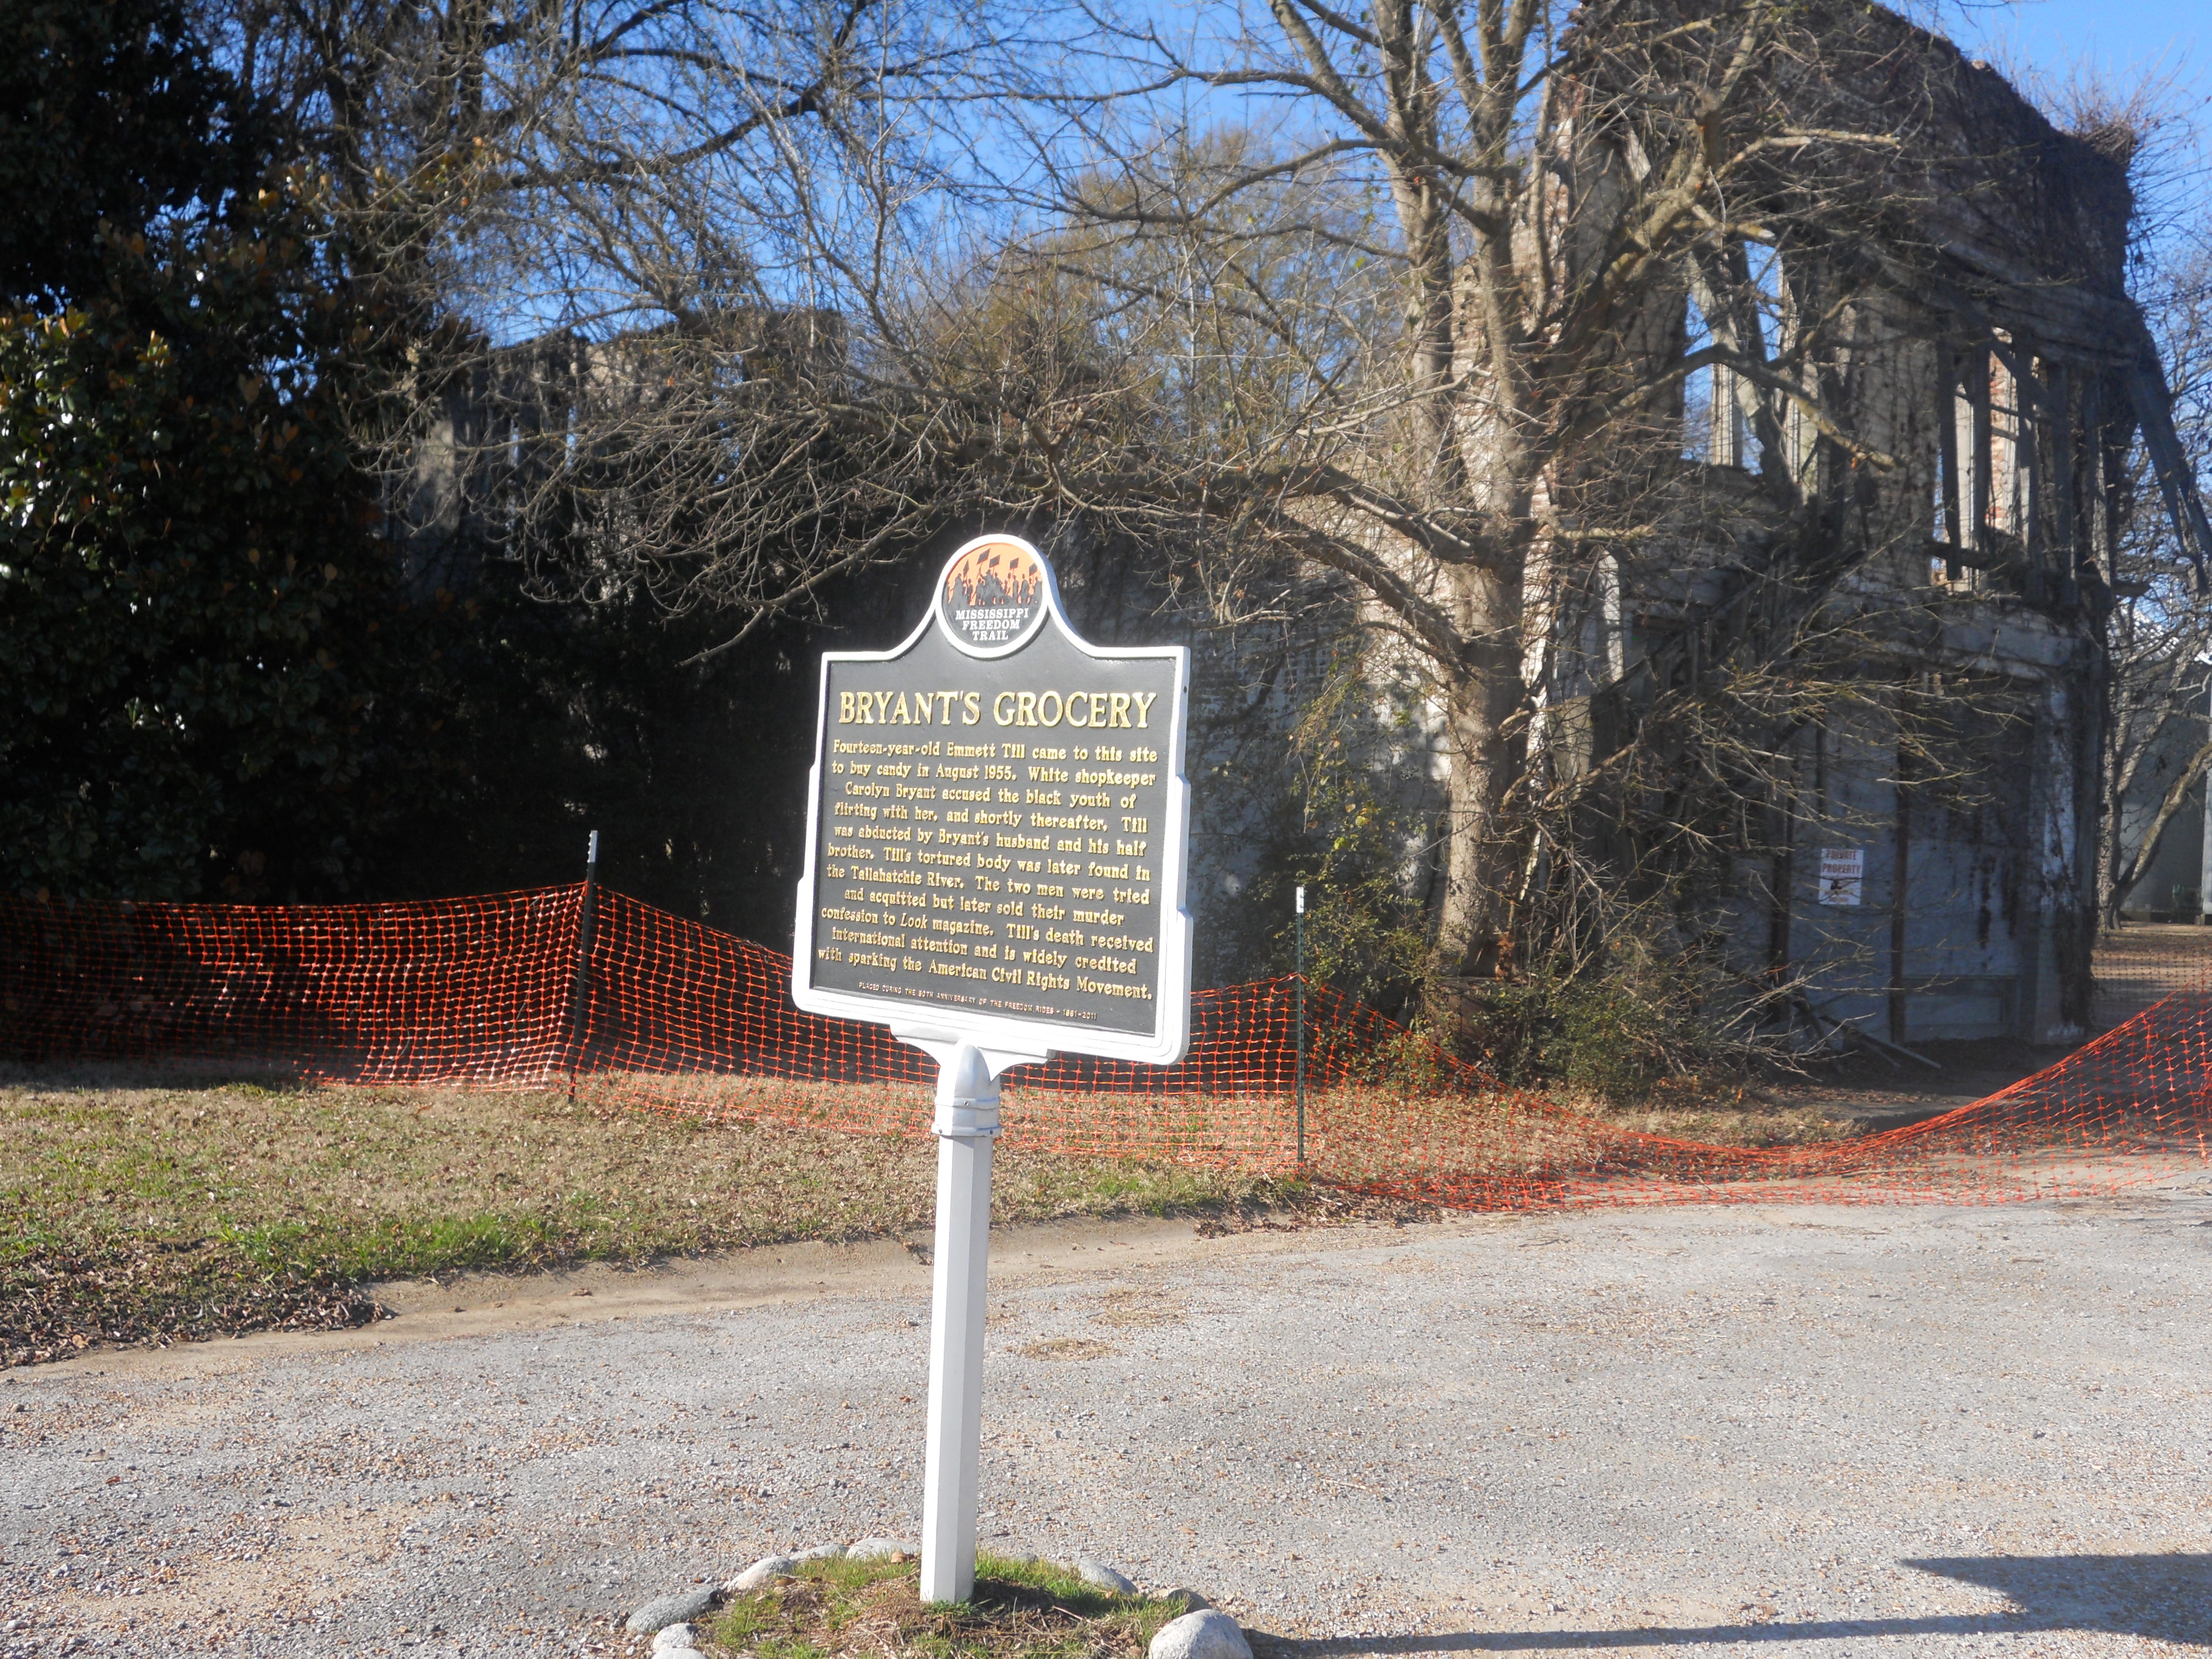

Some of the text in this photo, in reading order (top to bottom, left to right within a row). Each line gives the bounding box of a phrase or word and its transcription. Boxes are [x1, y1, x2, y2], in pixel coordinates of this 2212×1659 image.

[955, 608, 1029, 620] MISSISSIPPI
[962, 619, 1020, 630] FREEDOM
[972, 630, 1009, 640] TRAIL
[839, 691, 1157, 728] BRYANT'S GROCERY
[833, 739, 1157, 762] Fourteen-year-old Emmett Till came to this site
[832, 760, 1156, 789] to buy candy in August 1955. White shopkeeper
[845, 781, 1136, 808] Carolyn Bryant accused the black youth of
[834, 802, 1147, 833] flirting with her, and shortly thereafter, Till
[834, 825, 1147, 857] was abducted by Bryant's husband and his half
[1827, 849, 1856, 859] PRIVATE
[827, 842, 1150, 881] brother. Till's tortured body was later found in
[1822, 864, 1861, 873] PROPERTY
[827, 864, 1150, 905] the Tallahatchie River. The two men were tried
[844, 887, 1125, 926] and acquitted but later sold their murder
[821, 907, 1154, 953] confession to Look magazine. Till's death received
[831, 926, 1137, 974] international attention and is widely credited
[818, 947, 1152, 1000] with sparking the American Civil Rights Movement.
[859, 982, 879, 991] PLACED
[882, 985, 901, 994] DURING
[936, 993, 976, 1004] ANNIVERSARY
[990, 999, 1002, 1008] THE
[1004, 1001, 1032, 1011] FREEDOM
[1035, 1005, 1054, 1014] RIDES
